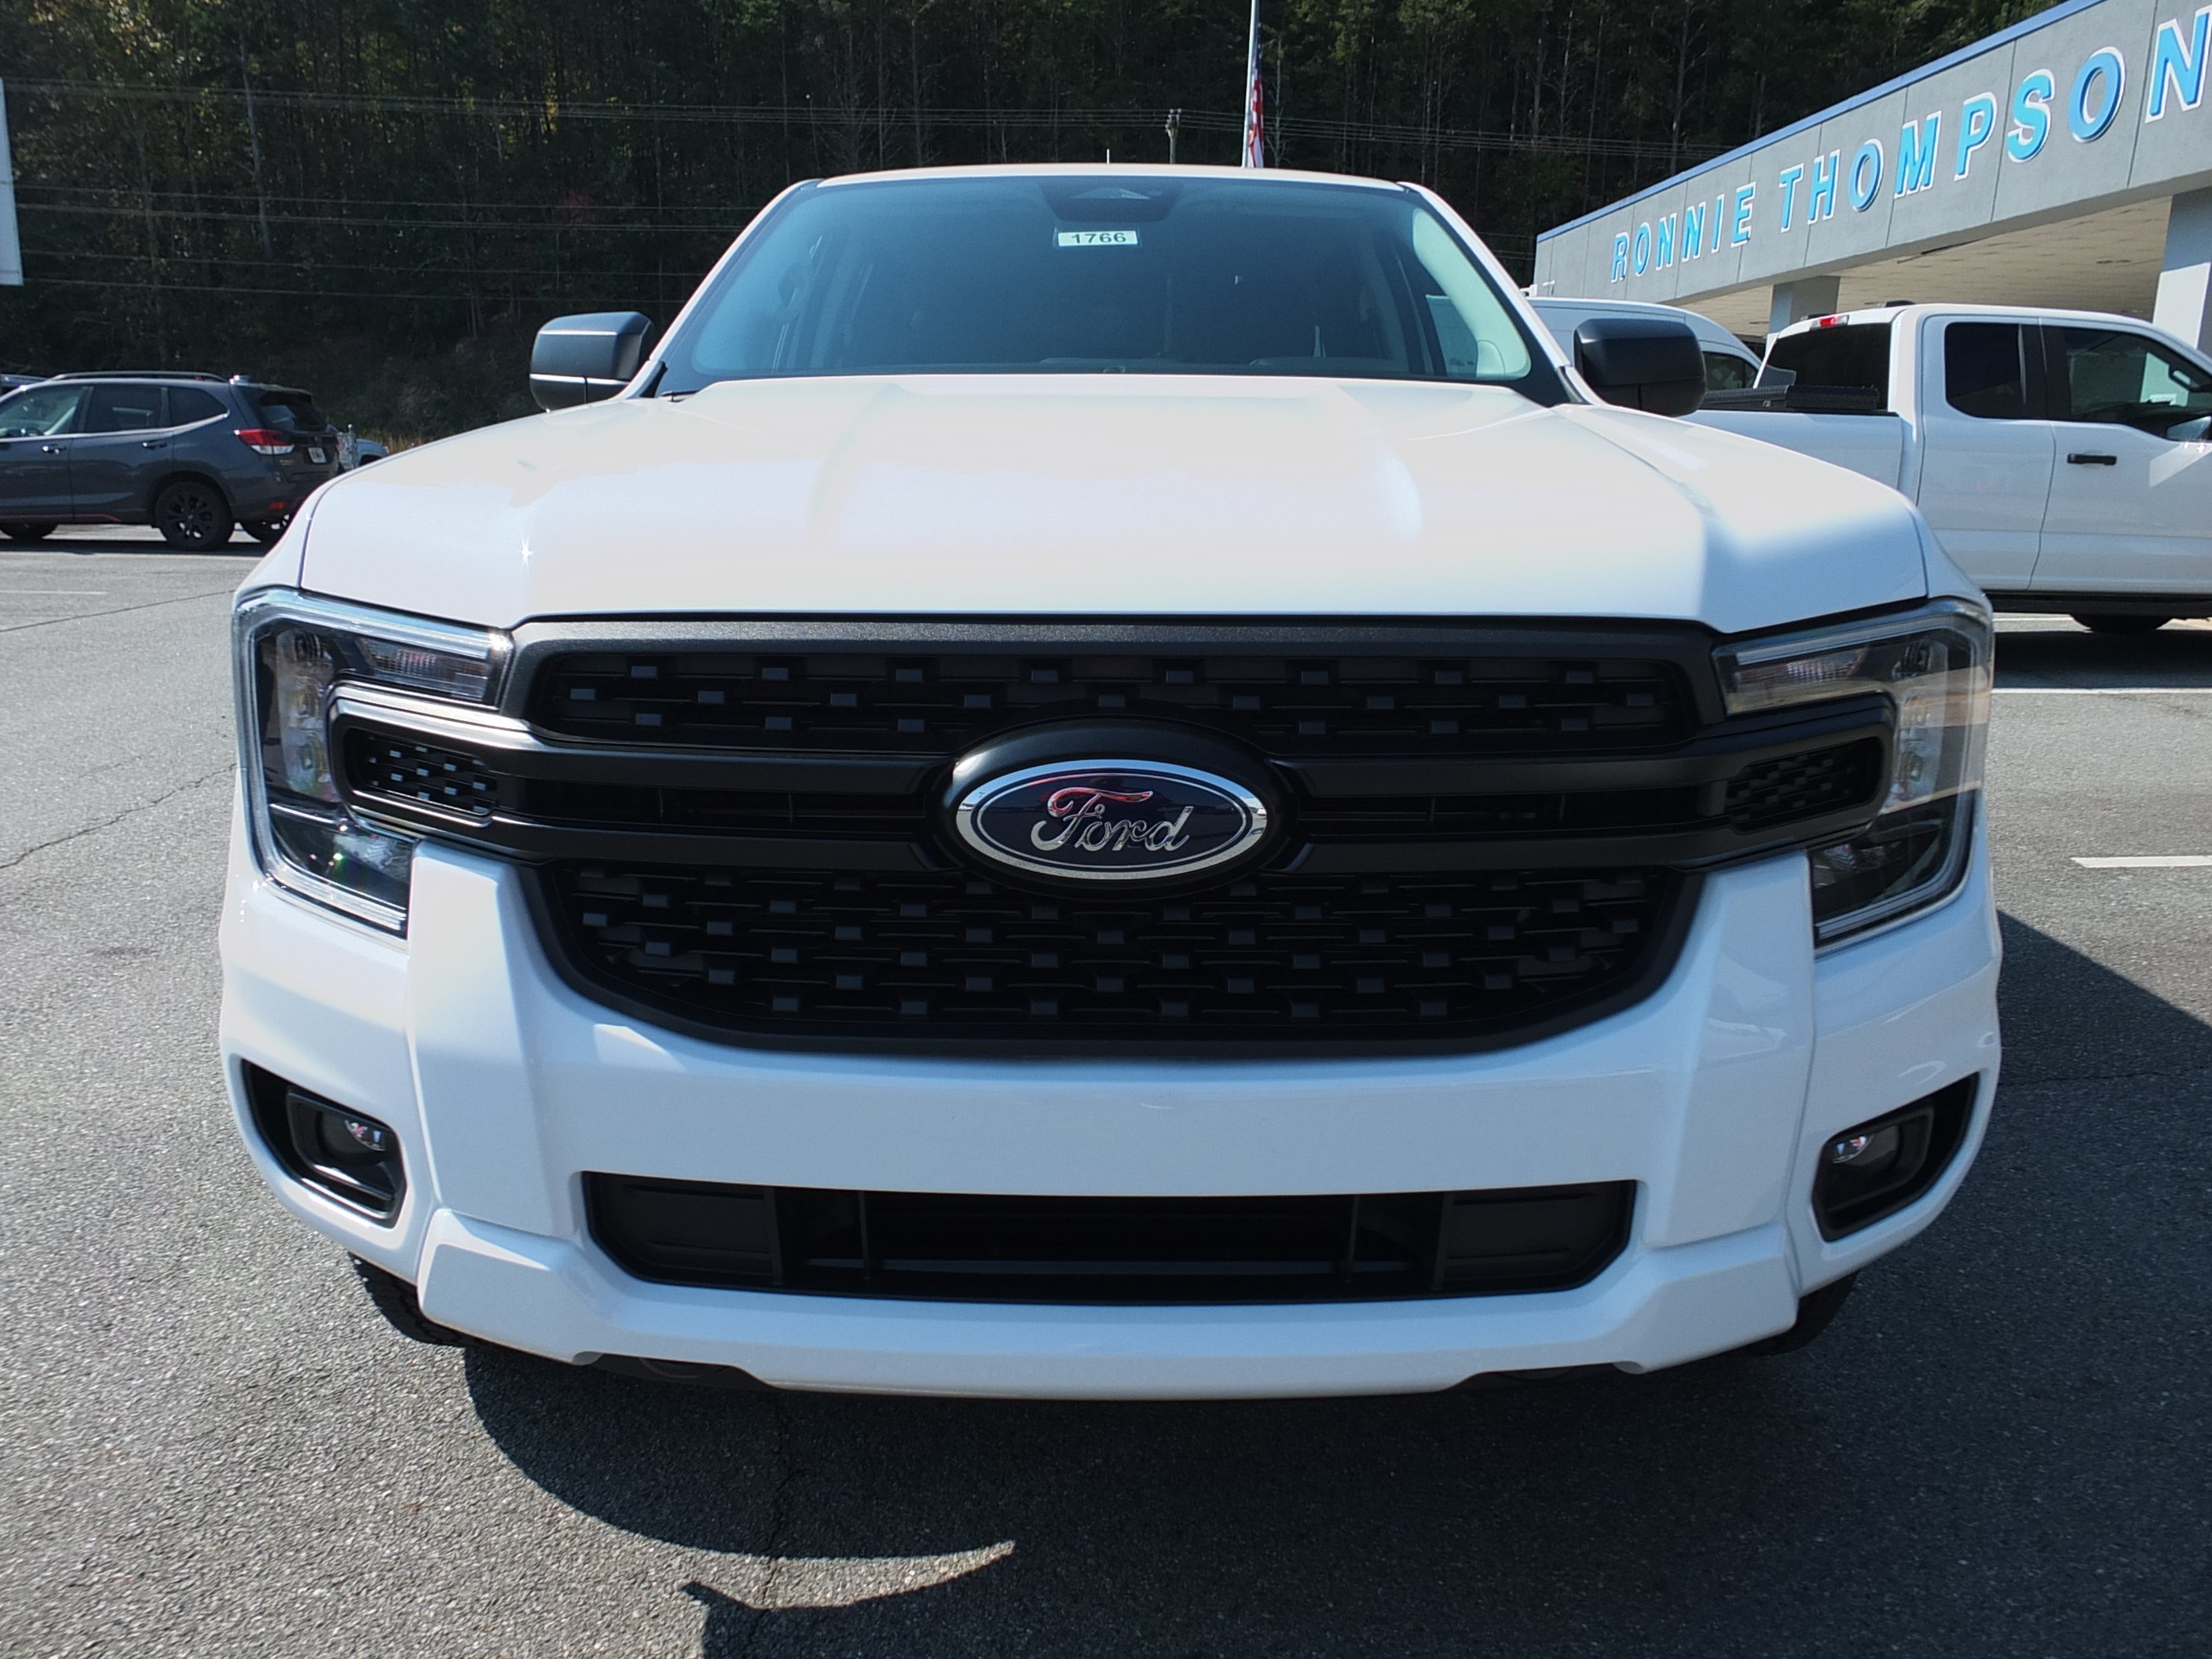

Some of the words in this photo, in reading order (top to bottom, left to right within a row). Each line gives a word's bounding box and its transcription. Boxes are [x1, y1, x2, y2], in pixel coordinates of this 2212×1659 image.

[1610, 181, 1756, 284] RONNIE
[1778, 5, 2212, 233] THOMPSON
[1071, 233, 1126, 244] 1766
[1031, 787, 1194, 851] Ford
